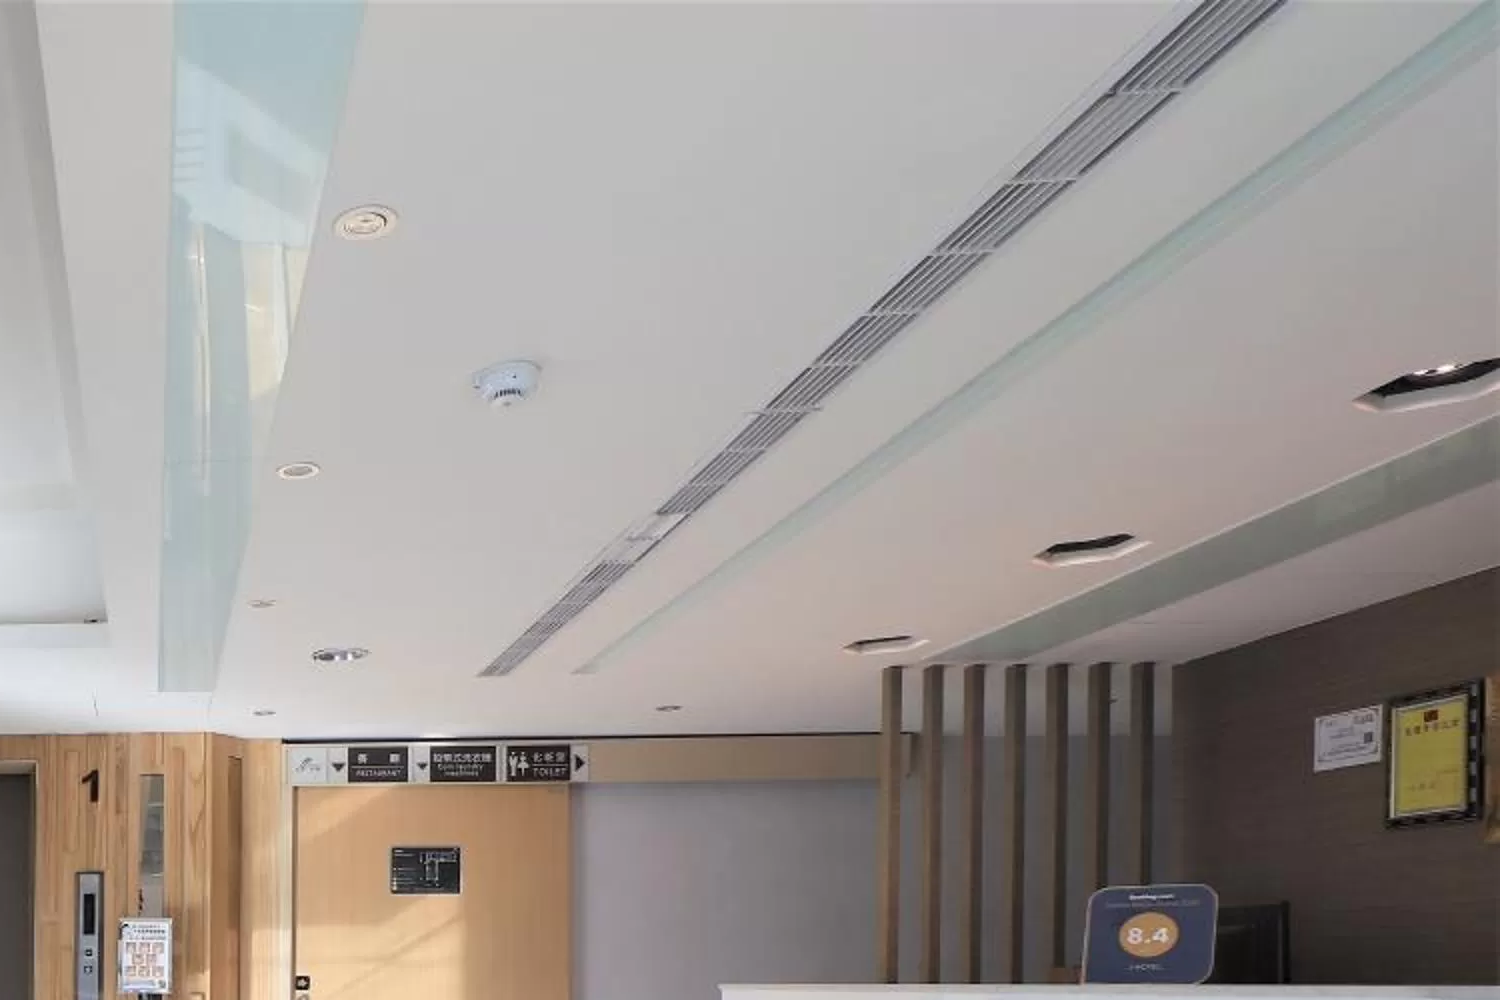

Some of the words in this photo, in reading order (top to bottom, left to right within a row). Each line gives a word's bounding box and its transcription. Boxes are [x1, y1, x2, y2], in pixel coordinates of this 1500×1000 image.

[533, 767, 567, 777] TOILET
[81, 769, 99, 803] 1
[1127, 927, 1169, 945] 8.4
